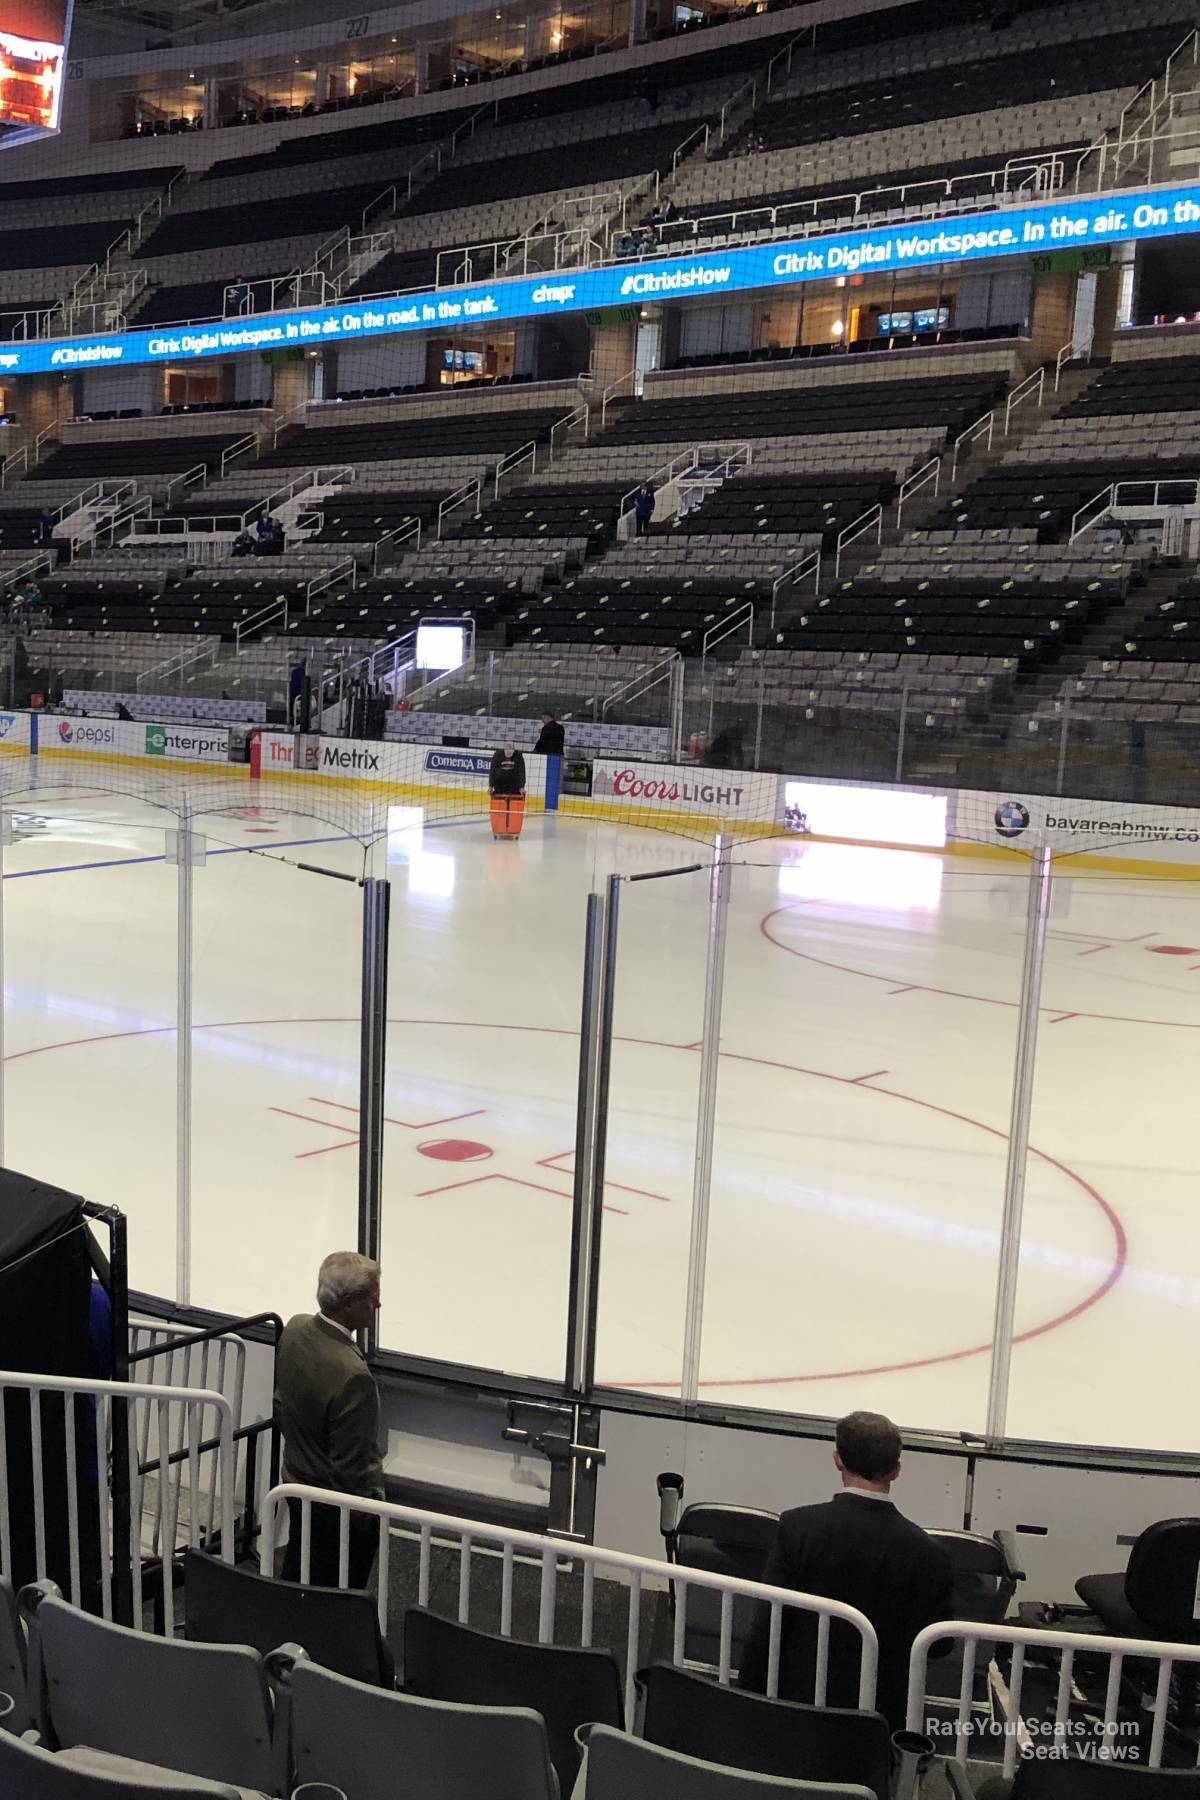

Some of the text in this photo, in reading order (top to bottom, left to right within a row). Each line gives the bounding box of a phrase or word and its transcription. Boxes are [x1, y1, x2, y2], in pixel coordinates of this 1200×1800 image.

[68, 62, 84, 79] 26
[773, 251, 824, 275] Citrix
[826, 240, 891, 270] Digital
[895, 226, 1018, 256] Workspace.
[1024, 220, 1043, 242] In
[1050, 215, 1088, 238] the
[1093, 209, 1128, 233] air.
[1133, 204, 1167, 227] On
[620, 266, 731, 295] #CitrixIsHow
[148, 336, 180, 354] Citrix
[181, 333, 219, 354] Digital
[221, 327, 285, 347] Workspace.
[286, 317, 299, 338] In
[300, 315, 321, 335] the
[343, 313, 361, 331] On
[363, 310, 384, 328] the
[386, 306, 420, 325] road.
[422, 304, 435, 321] In
[437, 301, 461, 318] the
[463, 296, 498, 315] tank.
[76, 726, 115, 743] pepsi
[147, 731, 228, 755] enterpris
[613, 769, 744, 806] Coors LIGHT
